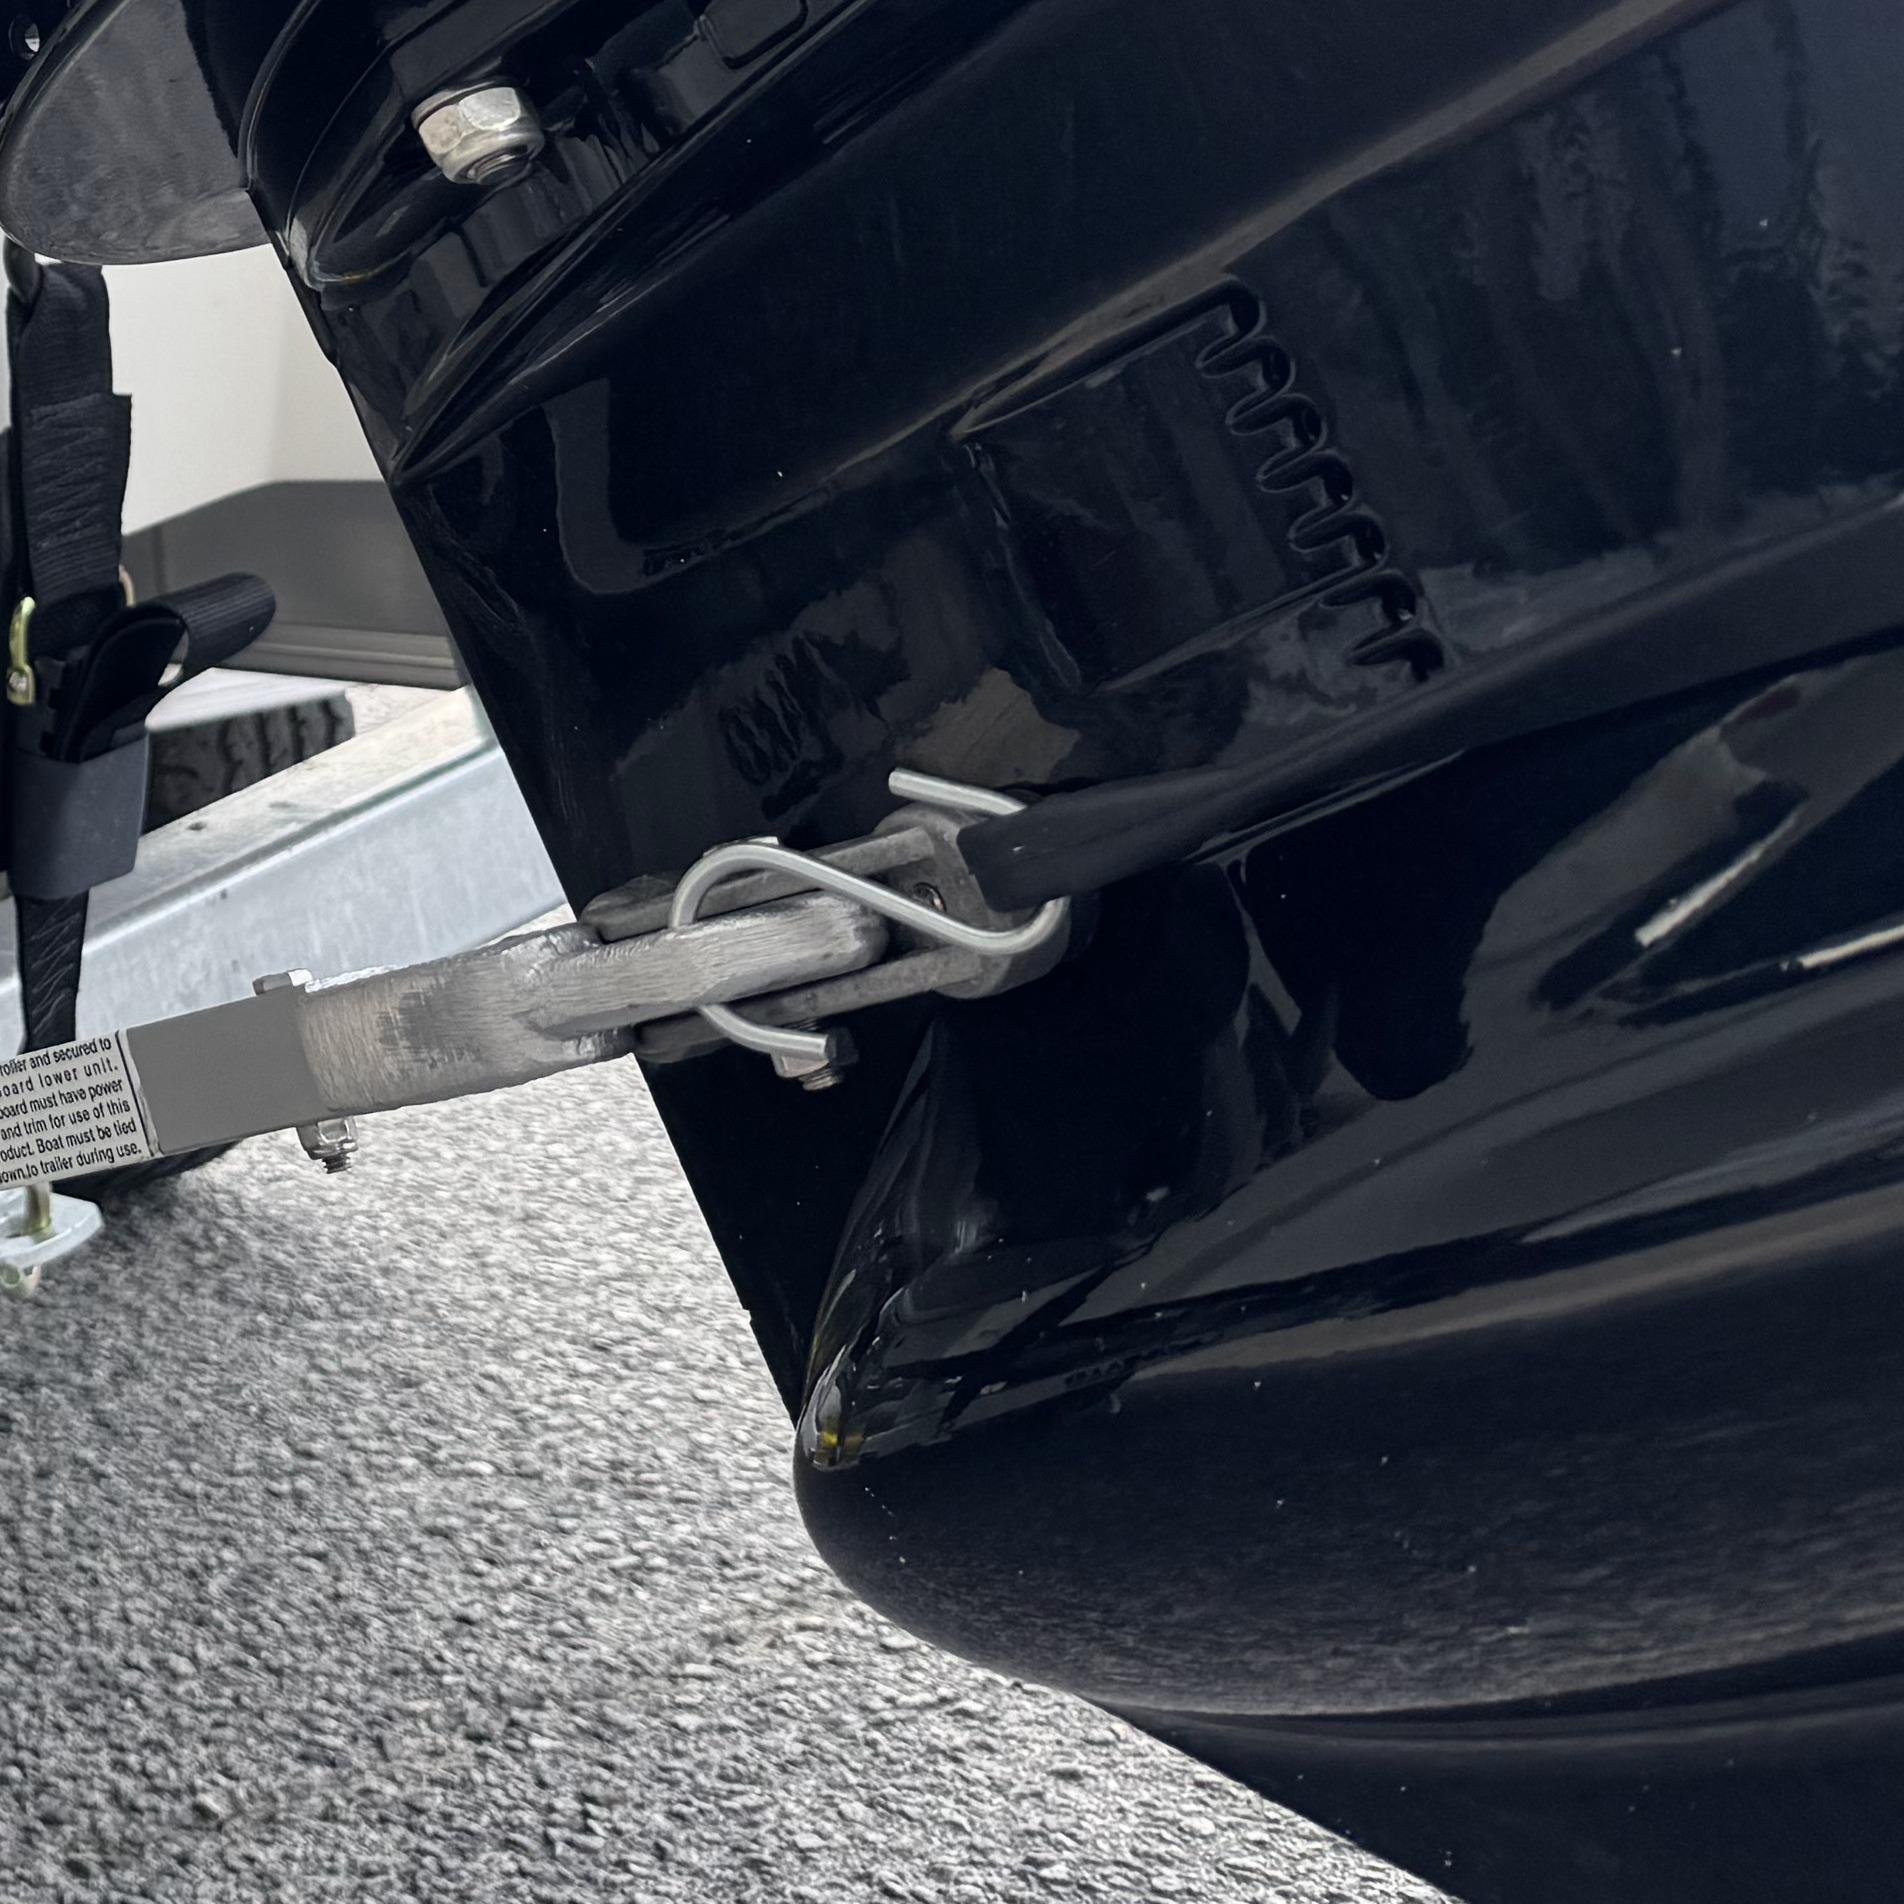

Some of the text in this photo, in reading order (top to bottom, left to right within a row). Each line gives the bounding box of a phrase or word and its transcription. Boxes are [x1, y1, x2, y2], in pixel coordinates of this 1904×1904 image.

[0, 1058, 27, 1076] roller
[30, 1051, 51, 1069] and
[53, 1038, 98, 1063] secured
[99, 1037, 111, 1051] to
[38, 1067, 77, 1088] lower
[84, 1057, 118, 1077] unit.
[30, 1092, 58, 1113] must
[59, 1087, 87, 1104] have
[88, 1079, 123, 1101] power
[1, 1122, 22, 1141] and
[23, 1117, 48, 1135] trim
[49, 1113, 66, 1129] for
[68, 1109, 90, 1125] use
[92, 1102, 105, 1119] of
[107, 1099, 131, 1115] this
[36, 1134, 63, 1153] Boat
[66, 1128, 96, 1147] must
[96, 1124, 112, 1139] be
[113, 1117, 136, 1136] tied
[26, 1163, 38, 1178] to
[40, 1155, 74, 1173] trailer
[76, 1147, 115, 1166] during
[117, 1143, 142, 1158] use.
